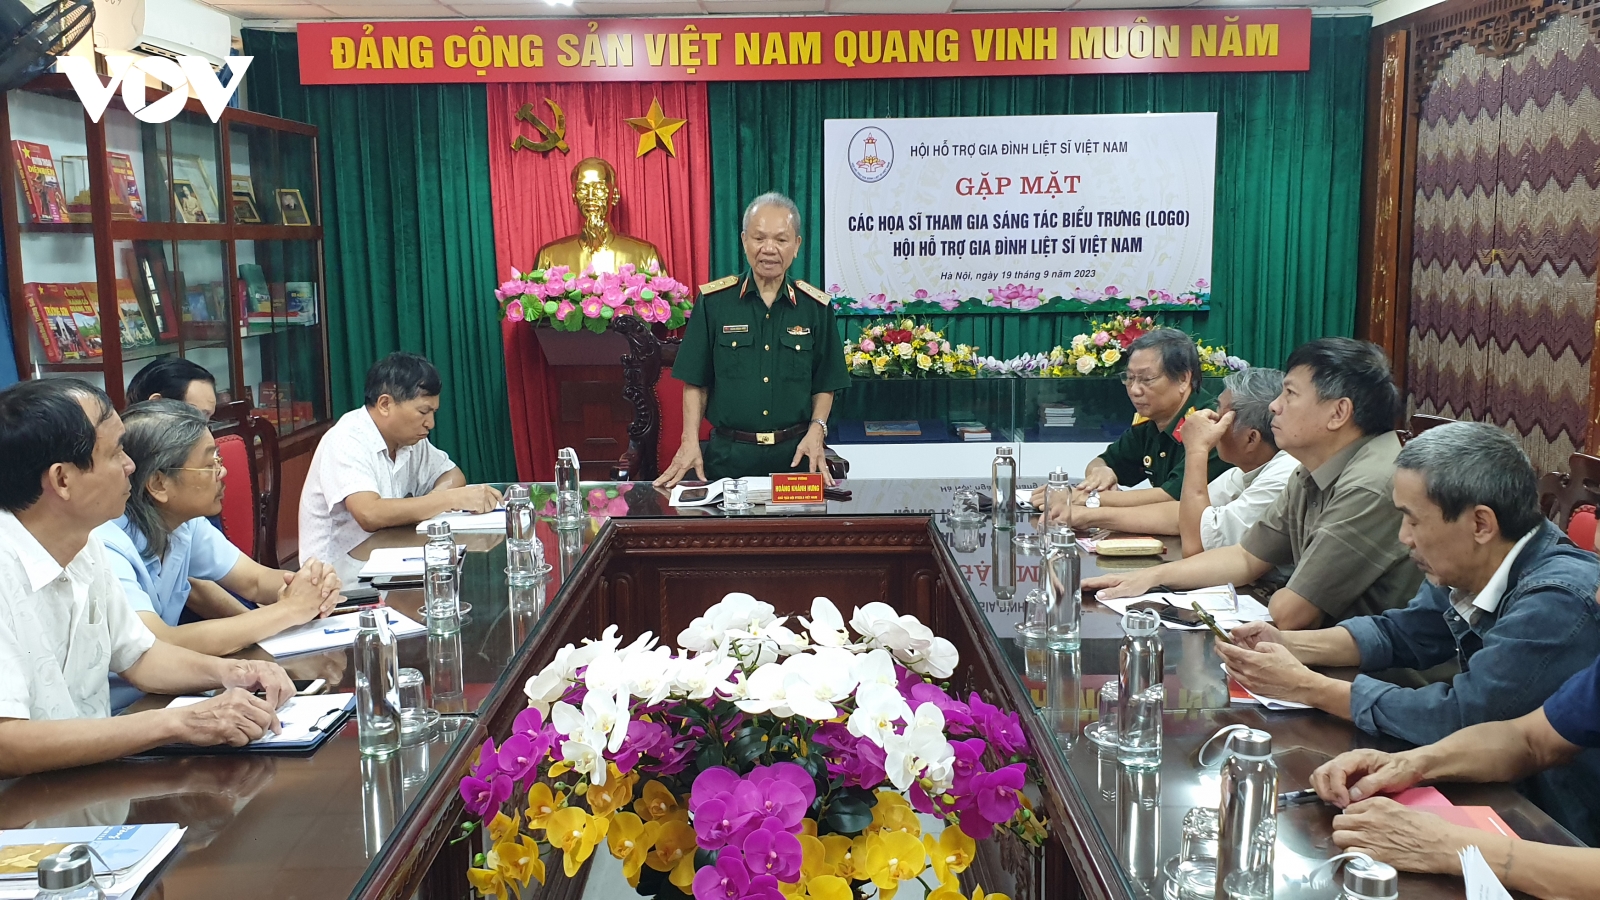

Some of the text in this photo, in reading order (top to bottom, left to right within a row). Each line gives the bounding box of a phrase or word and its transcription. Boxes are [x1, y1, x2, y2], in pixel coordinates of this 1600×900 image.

[331, 16, 1279, 76] ĐẢNG CỘNG SẢN VIỆT NAM QUANG VINH MUÔN NĂM
[910, 138, 1128, 159] HỘI HỖ TRỢ GIA ĐÌNH LIỆT SĨ VIỆT NAM
[956, 171, 1081, 200] GẶP MẶT
[848, 205, 1190, 234] CÁC HỌA SĨ THAM GIA SÁNG TÁC BIỂU TRƯNG (LOGO)
[893, 234, 1143, 260] HỘI HỖ TRỢ GIA ĐÌNH LIỆT SĨ VIỆT NAM
[940, 269, 1096, 282] Hà Nội, ngày 19 tháng 9 năm 2023
